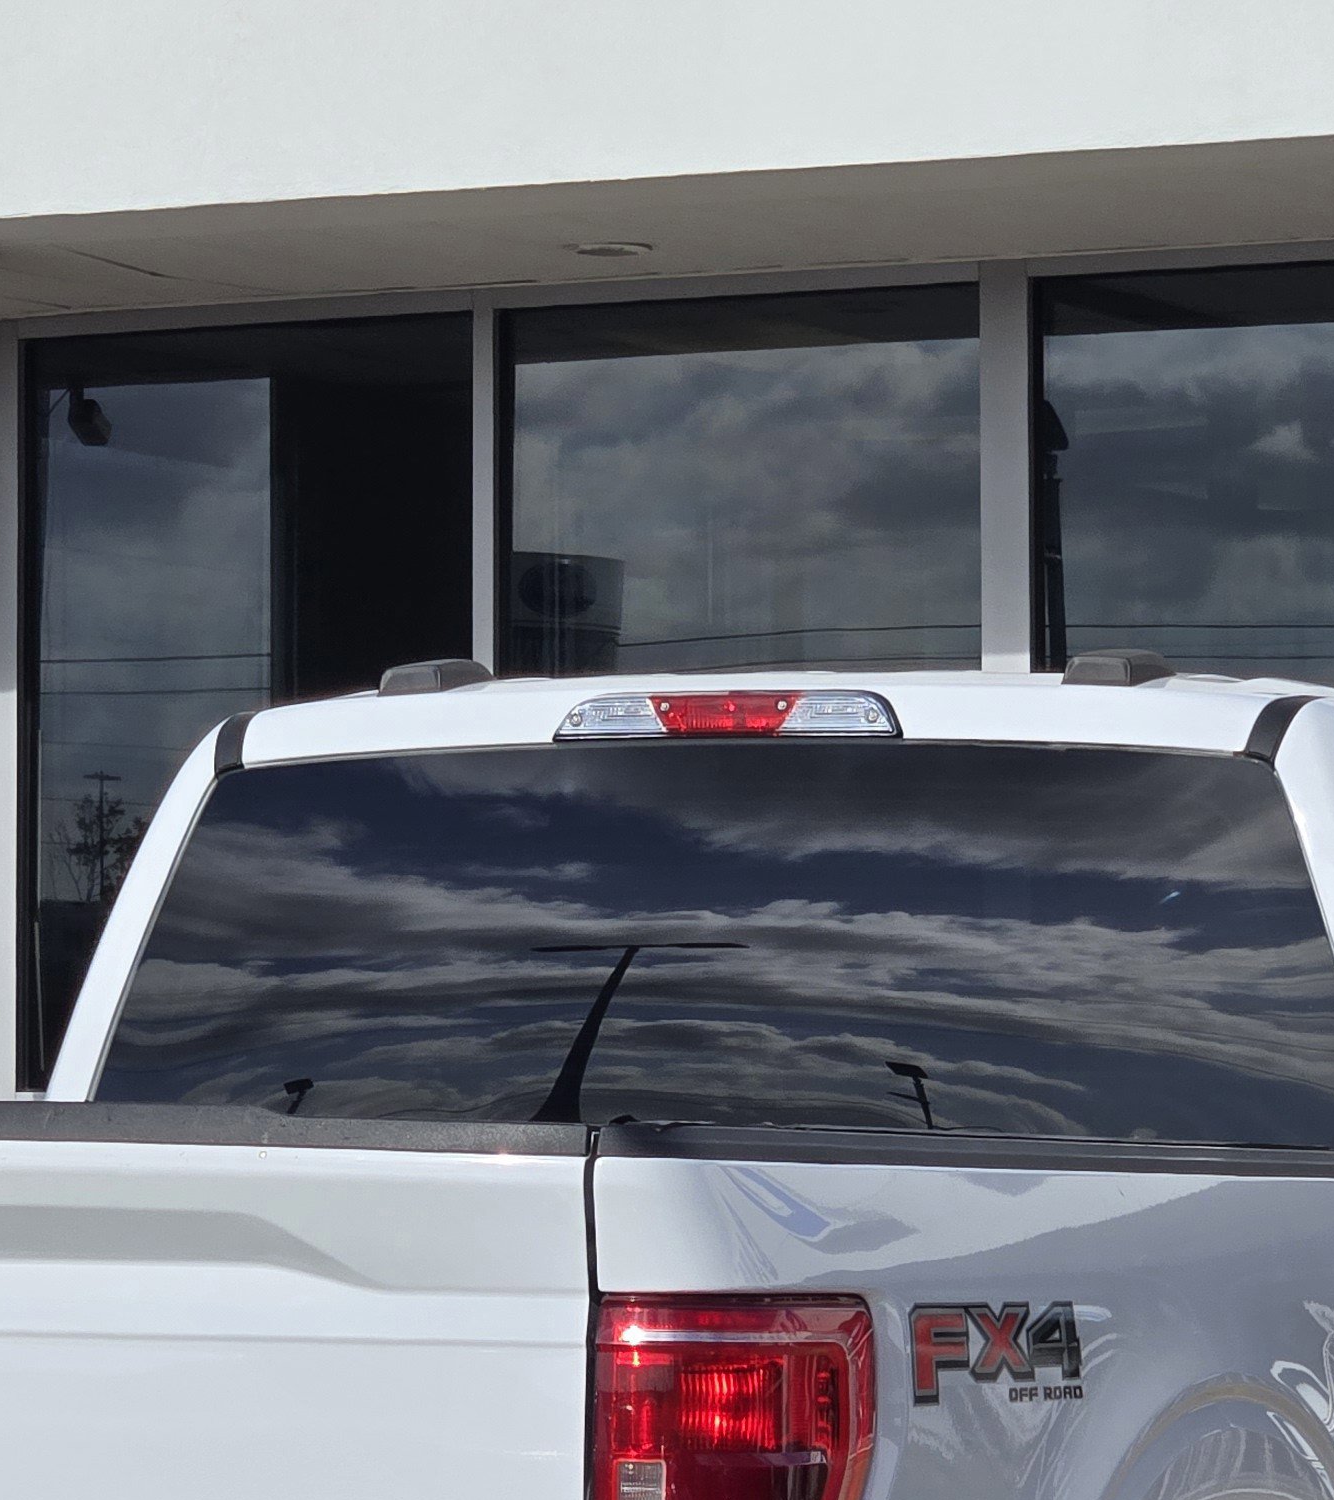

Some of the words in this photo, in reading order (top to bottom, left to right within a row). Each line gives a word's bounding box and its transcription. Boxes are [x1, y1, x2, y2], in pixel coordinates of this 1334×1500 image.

[908, 1300, 1083, 1407] FX4
[1008, 1385, 1039, 1403] OFF
[1044, 1385, 1084, 1401] ROAD
